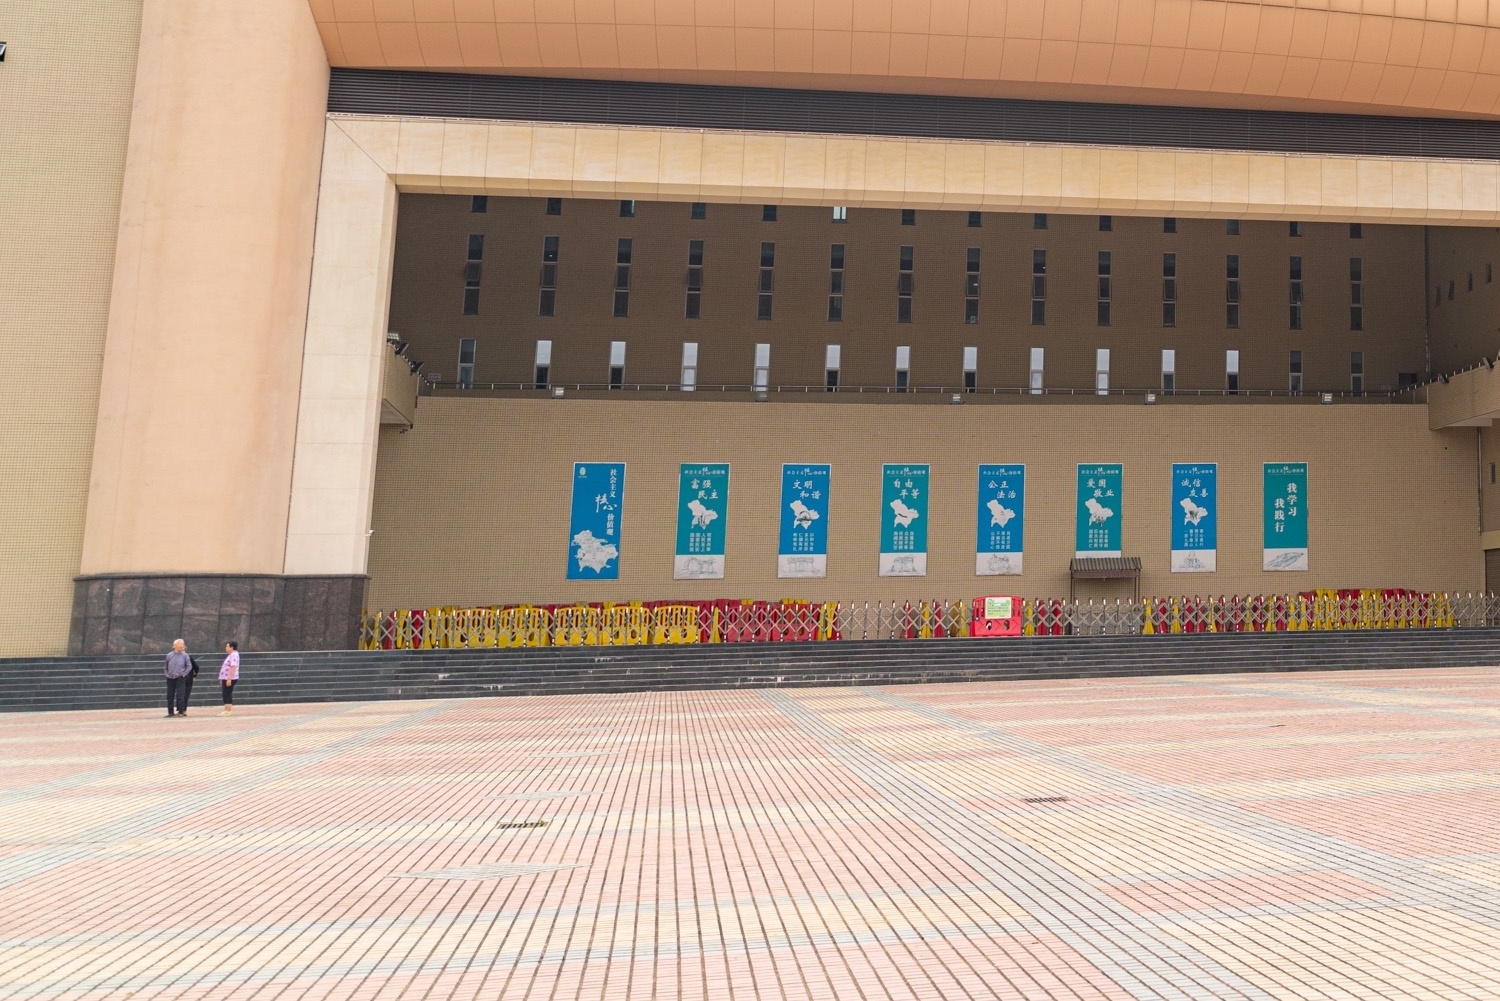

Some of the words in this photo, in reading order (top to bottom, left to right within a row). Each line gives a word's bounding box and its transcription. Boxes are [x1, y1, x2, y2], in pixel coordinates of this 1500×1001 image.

[609, 468, 618, 498] 社会主义
[691, 478, 712, 489] 富强
[792, 479, 813, 490] 文明
[893, 478, 913, 489] 自由
[988, 480, 1009, 489] 公正
[1087, 478, 1107, 488] 爱国
[1181, 478, 1202, 488] 诚信
[698, 489, 718, 500] 民主
[800, 490, 821, 500] 和谐
[900, 488, 920, 499] 平等
[997, 490, 1016, 499] 法治
[1094, 488, 1115, 498] 敬业
[1189, 487, 1208, 498] 友善
[1287, 482, 1298, 517] 我学习
[1274, 498, 1285, 533] 我践行
